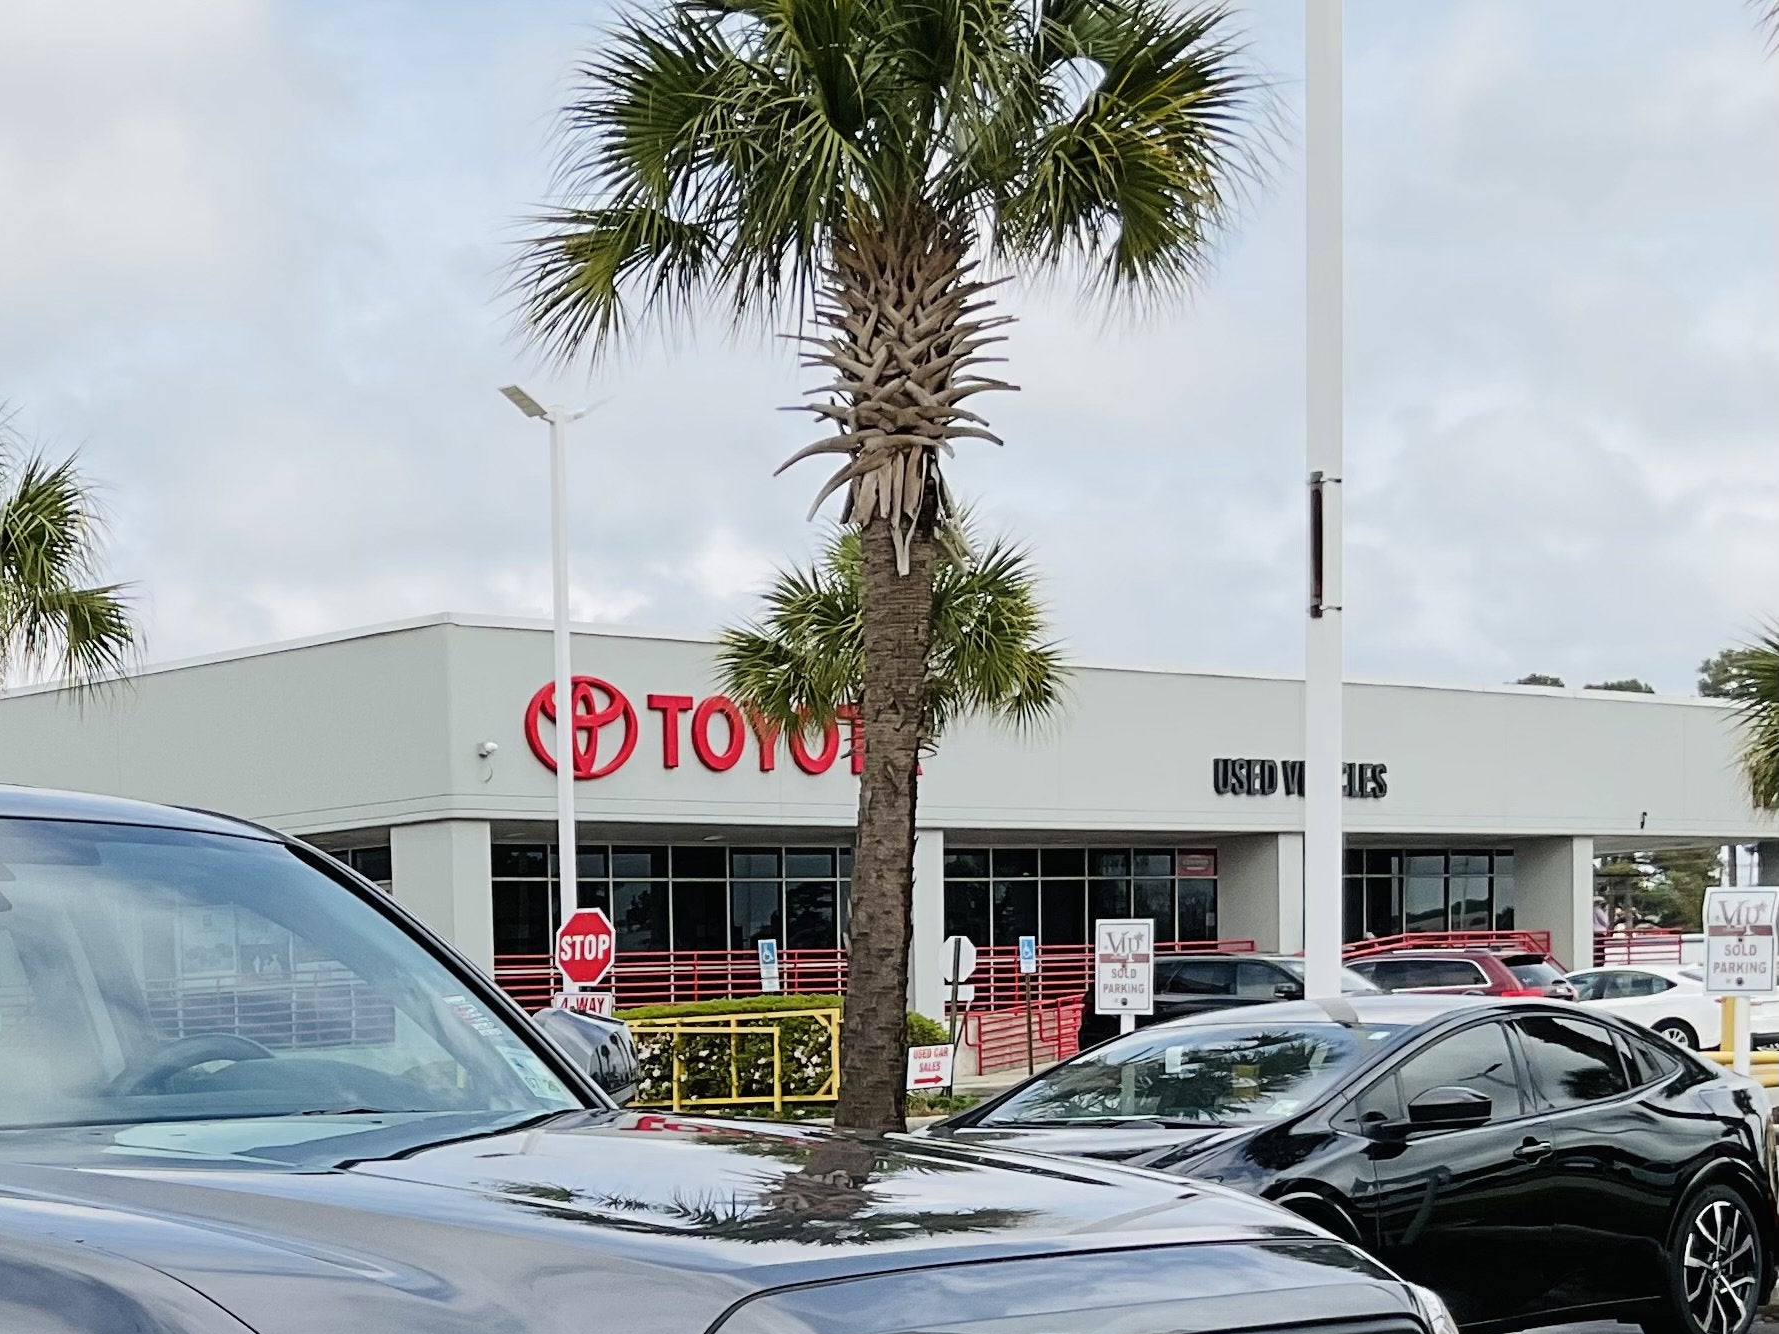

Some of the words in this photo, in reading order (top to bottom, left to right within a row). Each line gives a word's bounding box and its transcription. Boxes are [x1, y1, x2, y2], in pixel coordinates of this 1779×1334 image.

[647, 694, 922, 776] TOYOT
[1213, 758, 1278, 796] USED
[561, 934, 610, 961] STOP
[1724, 943, 1757, 956] SOLD
[1111, 968, 1137, 978] SOLD
[1713, 962, 1767, 974] PARKING
[1103, 983, 1145, 994] PARKING
[913, 1048, 932, 1059] USED
[933, 1046, 949, 1058] CAR
[919, 1061, 941, 1073] SALES
